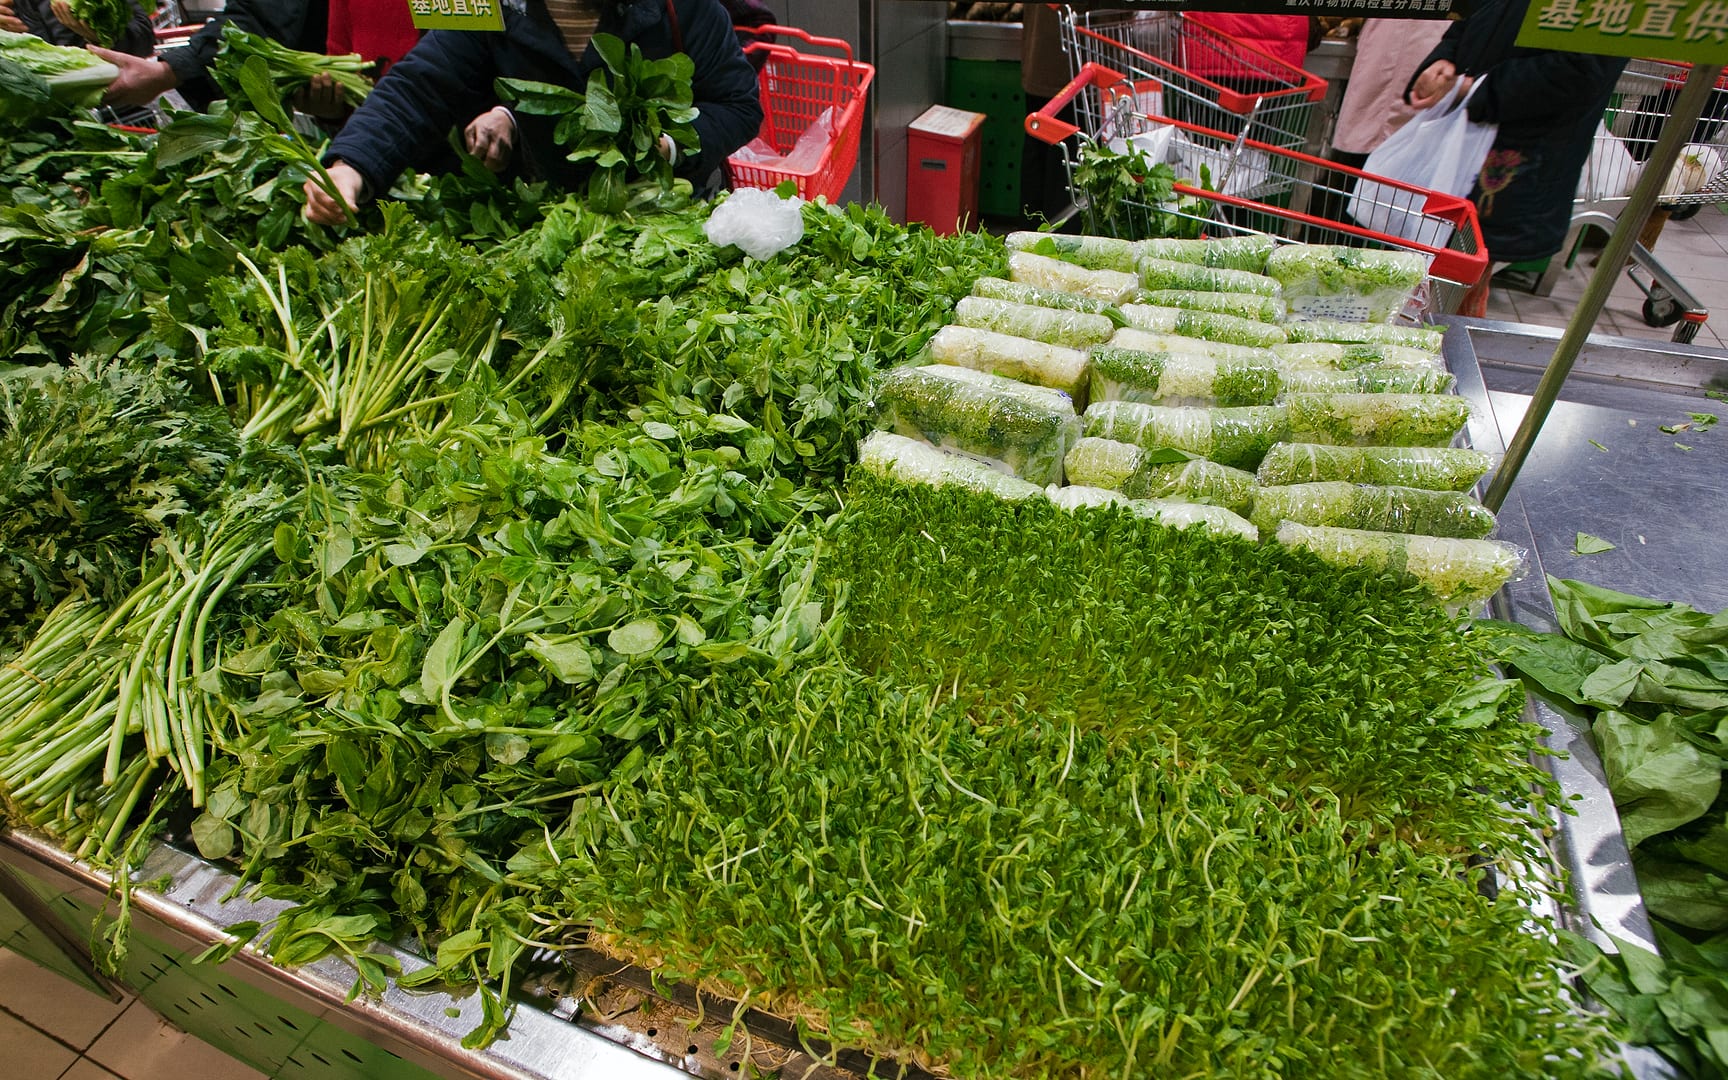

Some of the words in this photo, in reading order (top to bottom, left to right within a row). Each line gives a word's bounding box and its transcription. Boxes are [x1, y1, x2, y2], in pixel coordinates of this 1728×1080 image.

[412, 0, 492, 15] 基地直供
[1538, 0, 1728, 41] 基地直供
